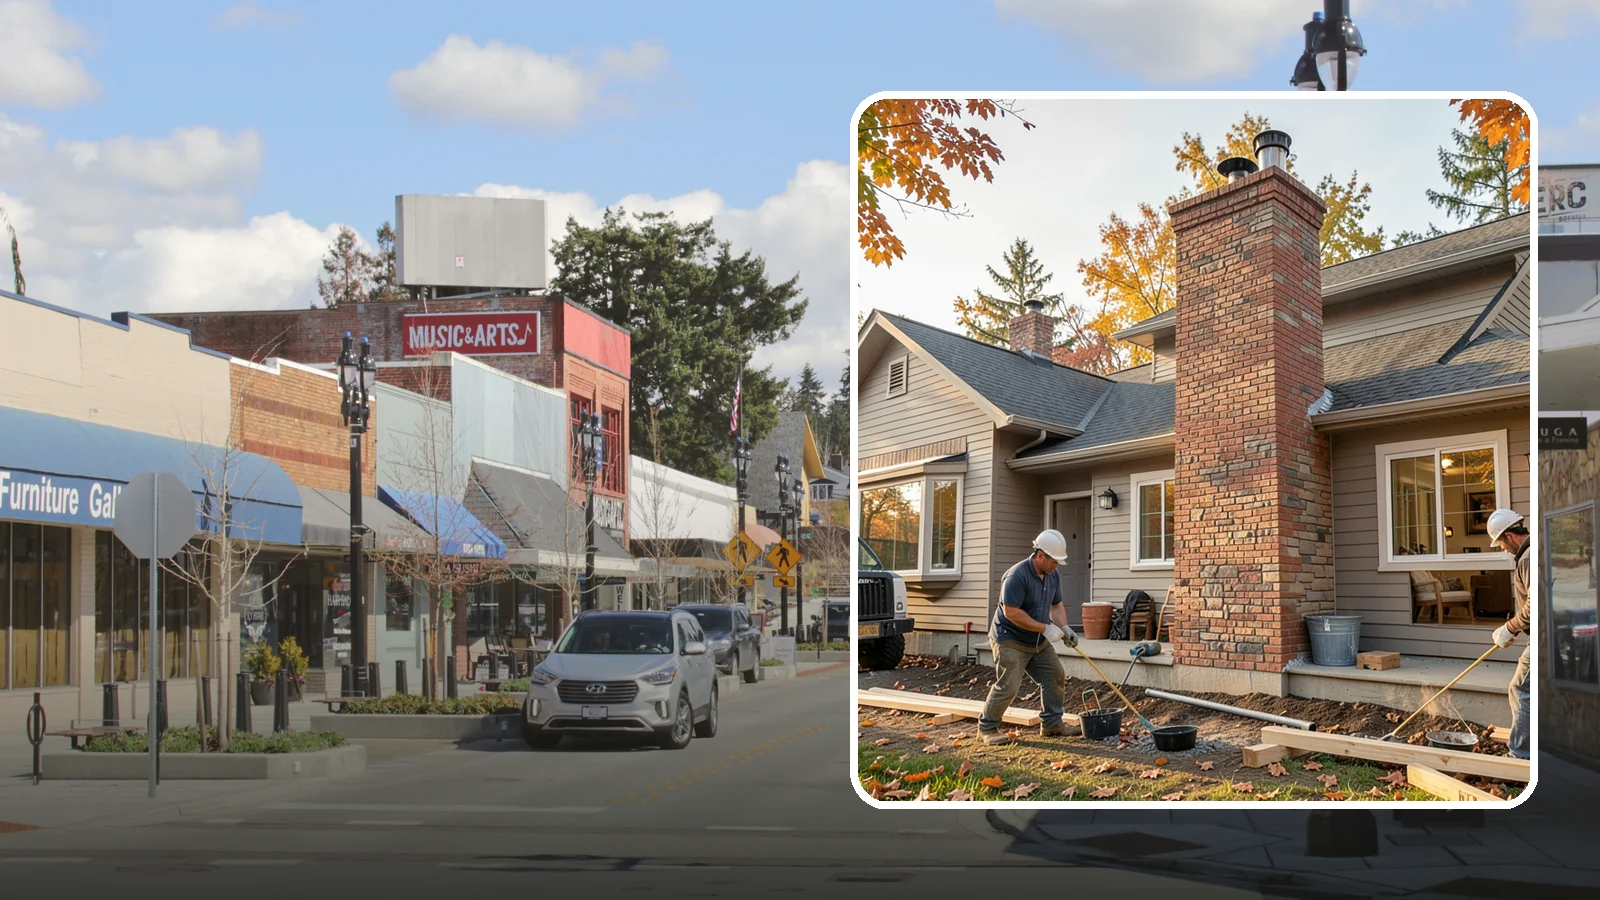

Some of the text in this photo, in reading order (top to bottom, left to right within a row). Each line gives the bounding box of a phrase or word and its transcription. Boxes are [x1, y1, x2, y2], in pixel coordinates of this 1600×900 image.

[1540, 427, 1578, 437] UGA
[0, 471, 121, 519] Furniture Gal
